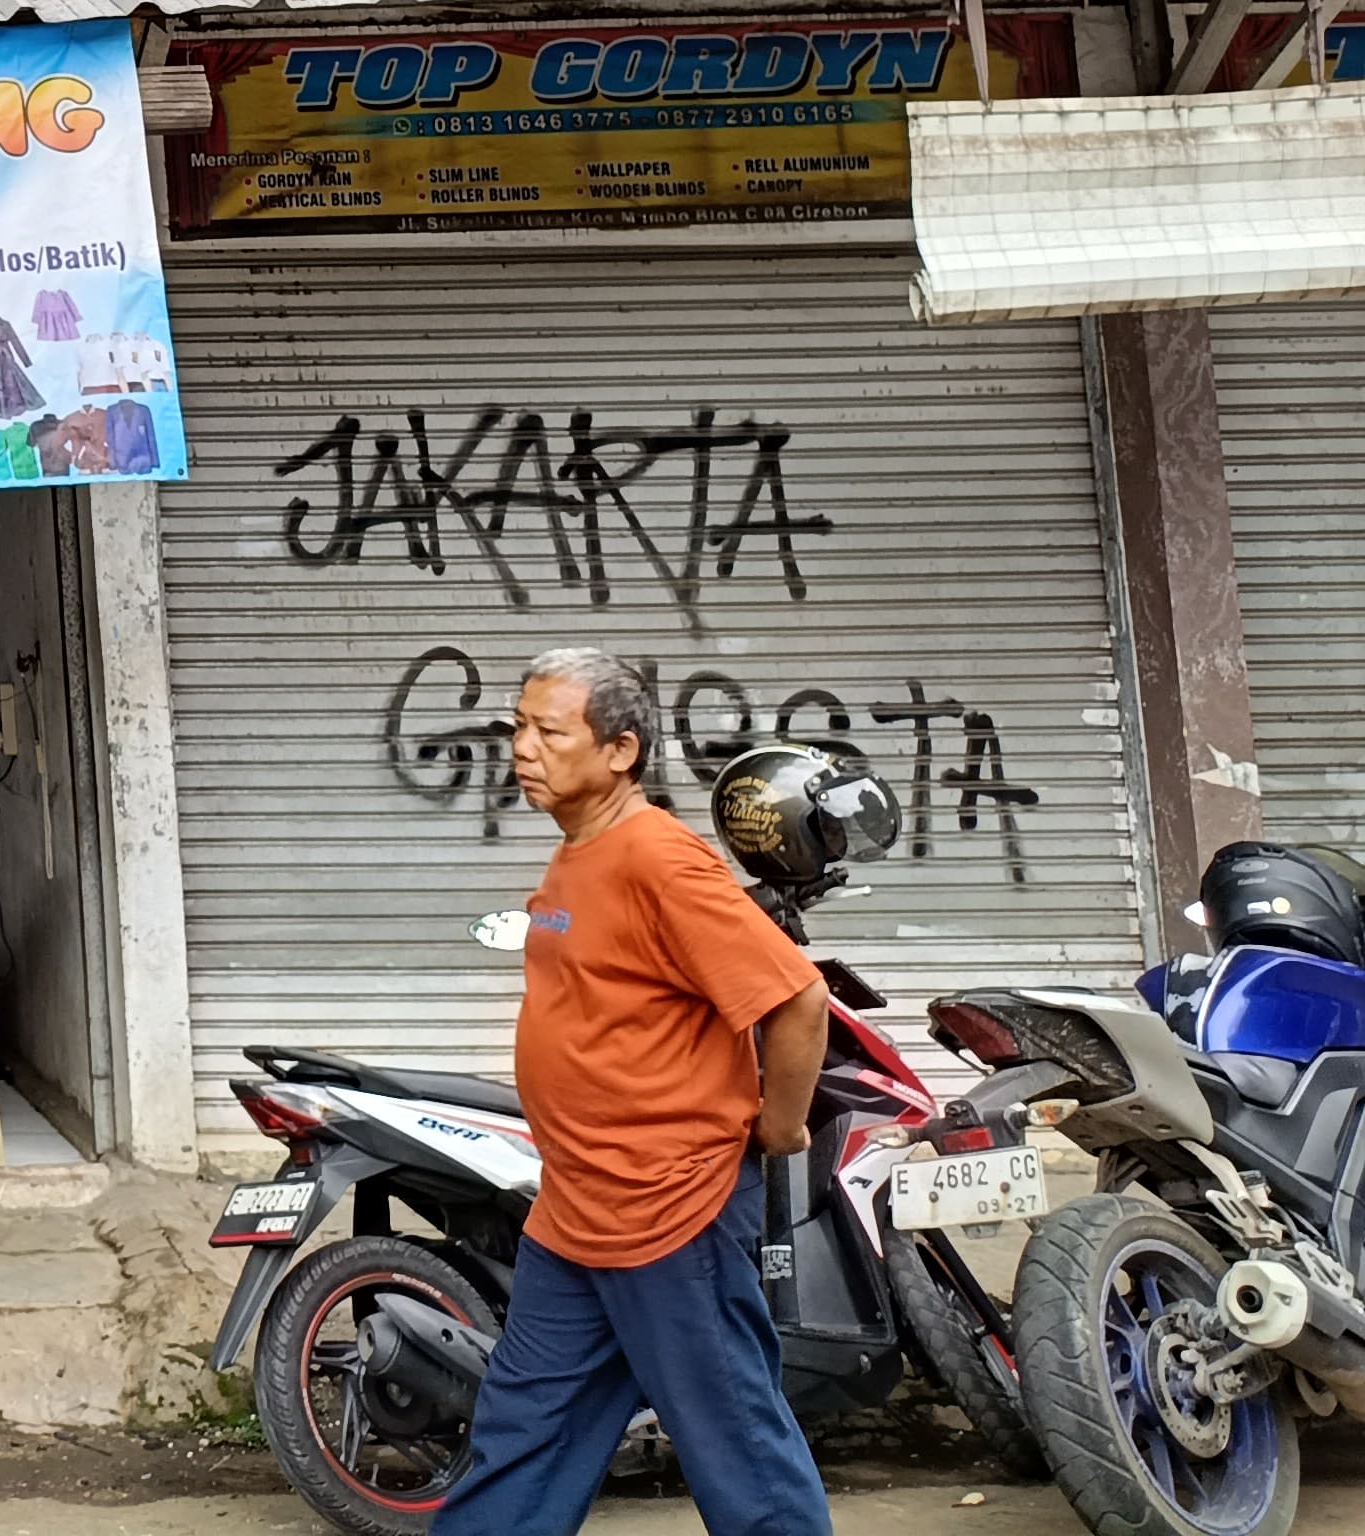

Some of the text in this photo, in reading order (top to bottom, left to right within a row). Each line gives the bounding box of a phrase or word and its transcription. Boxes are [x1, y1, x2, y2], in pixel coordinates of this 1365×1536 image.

[284, 26, 955, 111] TOP GORDYN
[433, 115, 493, 134] 0813
[503, 113, 562, 131] 1646
[572, 111, 631, 128] 3775
[657, 109, 715, 126] 0877
[725, 106, 784, 124] 2910
[794, 103, 853, 122] 6165
[190, 151, 278, 167] Menerima
[745, 156, 870, 173] RELL ALUMUNIUM
[429, 167, 499, 183] SLIM LINE
[588, 162, 671, 177] WALLPAPER
[258, 172, 314, 188] GORDYN
[747, 179, 803, 194] CANOPY
[431, 187, 540, 204] ROLLER BLINDS
[589, 181, 706, 198] WOODEN BLINDS
[258, 192, 382, 208] VERTICAL BLINDS
[792, 205, 868, 219] Cirebon
[274, 407, 834, 638] JAKARTA
[897, 1154, 1036, 1195] E 4682 CG
